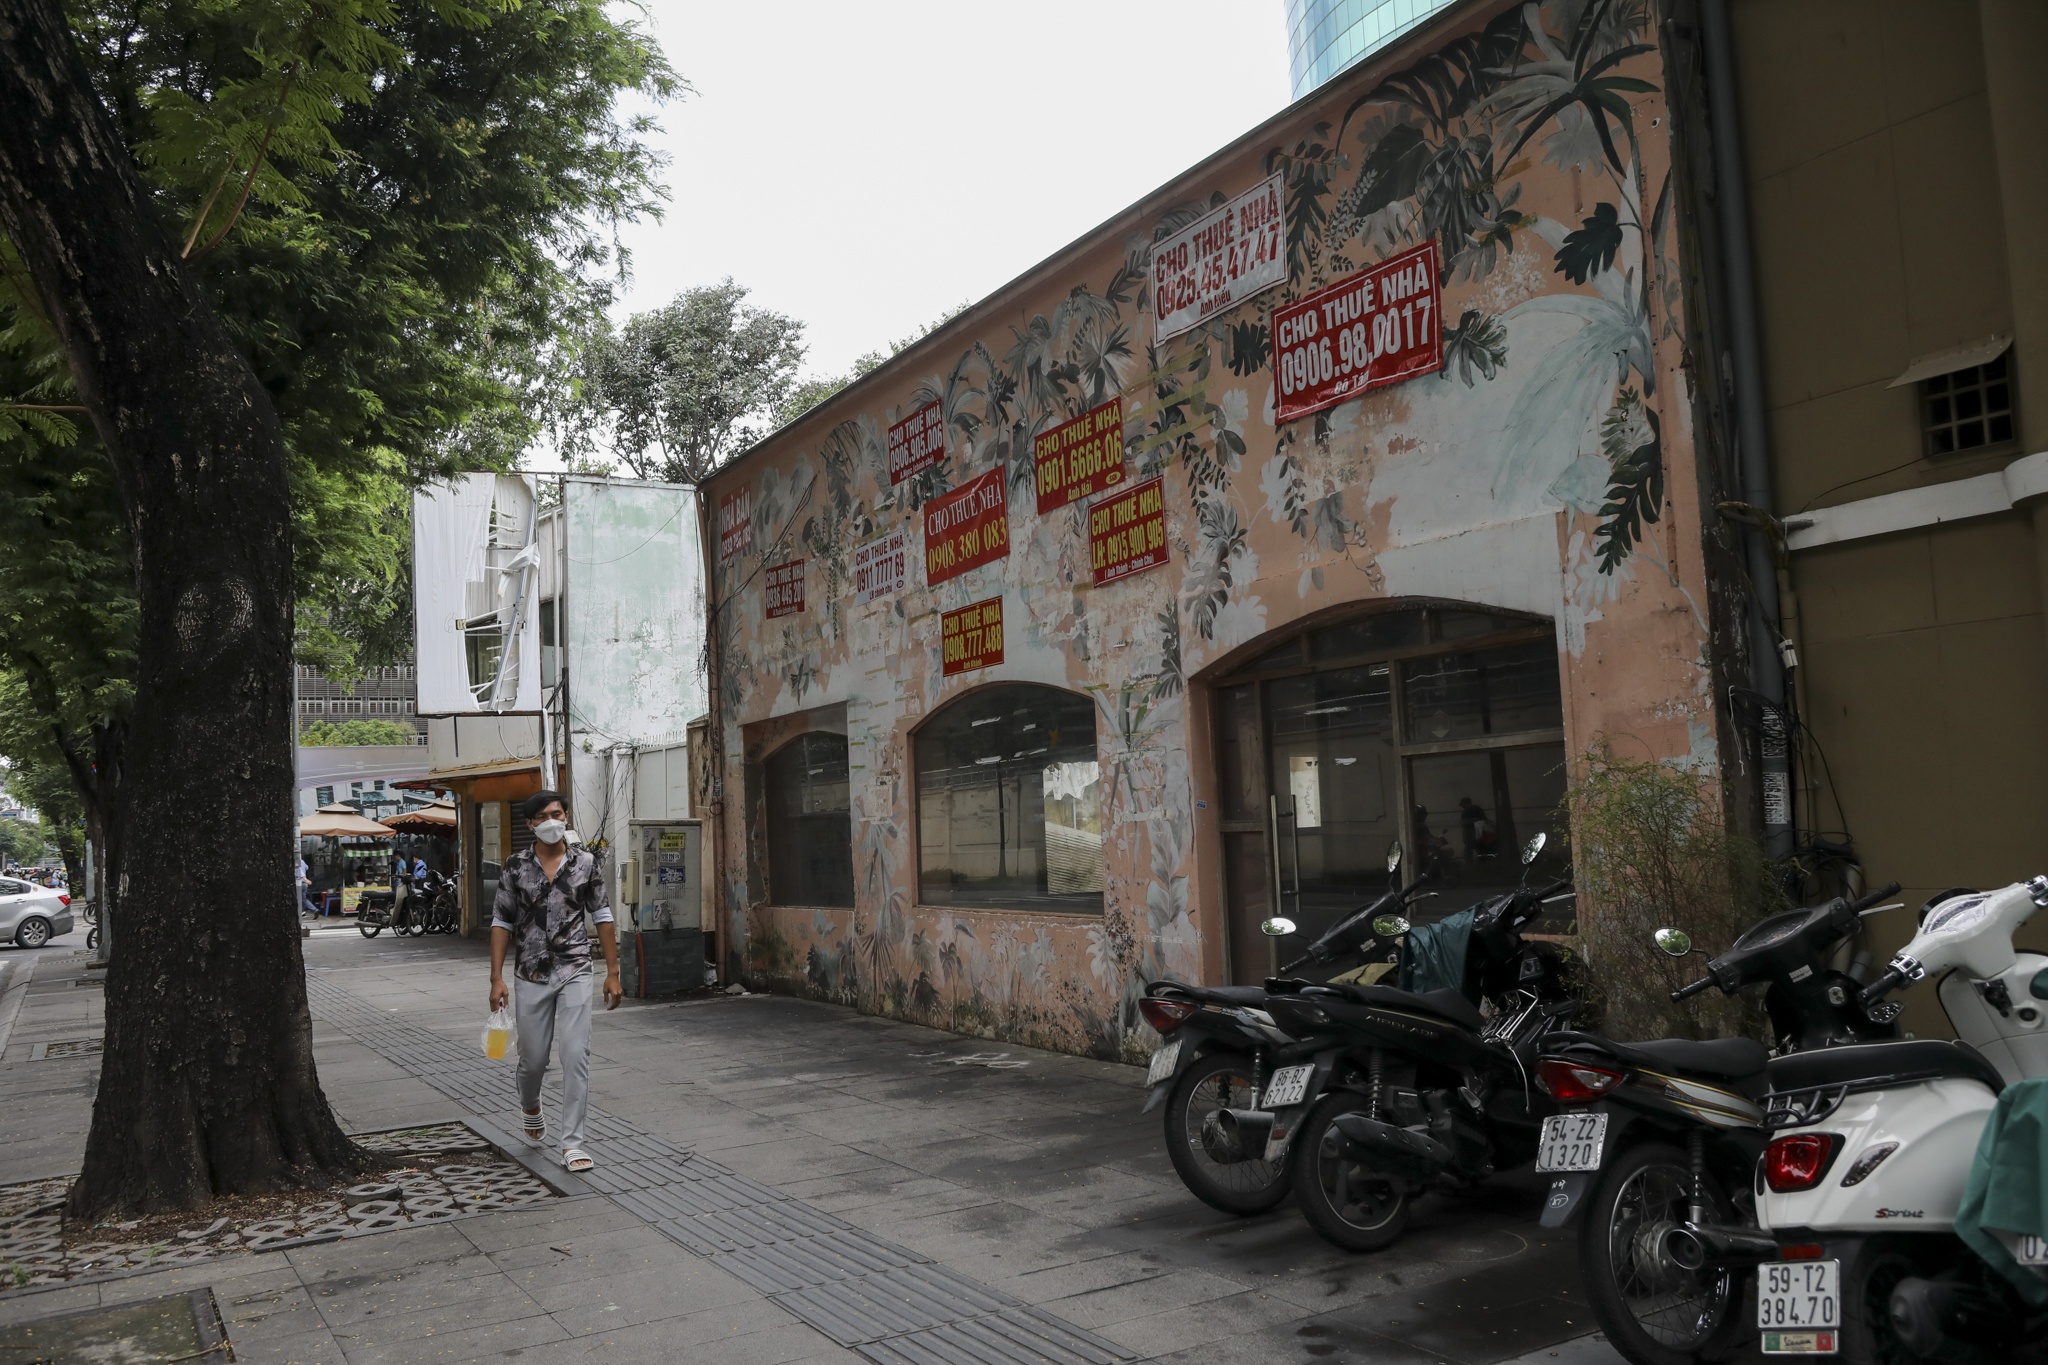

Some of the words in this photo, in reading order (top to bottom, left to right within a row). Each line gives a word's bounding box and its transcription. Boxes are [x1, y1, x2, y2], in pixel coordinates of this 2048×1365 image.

[1156, 241, 1188, 284] CHO
[1192, 209, 1234, 263] THUÊ
[1240, 184, 1279, 236] NHÀ
[1156, 222, 1280, 320] 0925.45.47.47
[1279, 310, 1318, 348] CHO
[1322, 279, 1375, 329] THUÊ
[1382, 257, 1429, 306] NHÀ
[890, 426, 903, 448] CHO
[905, 410, 923, 439] THUÊ
[926, 401, 941, 428] NHÀ
[1037, 433, 1059, 459] CHO
[1062, 414, 1092, 447] THUÊ
[1096, 400, 1120, 432] NHÀ
[890, 423, 942, 473] 0906.905.006
[1038, 430, 1122, 496] 0901.6666.06
[721, 494, 735, 534] NHÀ
[736, 486, 750, 521] BÁN
[928, 508, 948, 536] CHO
[949, 488, 977, 525] THUÊ
[978, 475, 1002, 512] NHÀ
[1068, 486, 1079, 501] Anh
[1092, 508, 1110, 536] CHO
[1113, 492, 1137, 527] THUÊ
[1140, 483, 1161, 517] NHÀ
[856, 549, 869, 566] CHO
[871, 538, 887, 559] THUÊ
[890, 531, 903, 551] NHÀ
[929, 540, 955, 574] 0908
[958, 529, 980, 562] 380
[984, 517, 1007, 550] 083
[1093, 540, 1106, 570] LH:
[1108, 531, 1128, 564] 0915
[1129, 524, 1145, 556] 900
[1147, 517, 1163, 550] 905
[766, 571, 776, 587] CHO
[778, 564, 791, 584] THUÊ
[793, 560, 803, 580] NHÀ
[857, 564, 873, 592] 0911
[876, 556, 892, 585] 7777
[895, 552, 904, 577] 69
[944, 616, 959, 636] CHO
[961, 606, 981, 631] THUÊ
[983, 600, 1000, 625] NHÀ
[944, 624, 1001, 663] 0908.777.488
[1265, 1086, 1303, 1104] 621.22
[1275, 1068, 1306, 1087] 86-B2
[1551, 1119, 1596, 1142] 54-Z2
[1547, 1144, 1592, 1167] 1320
[1875, 1208, 1924, 1219] Sprint
[1769, 1265, 1826, 1294] 59-T2
[1761, 1296, 1833, 1326] 384.70
